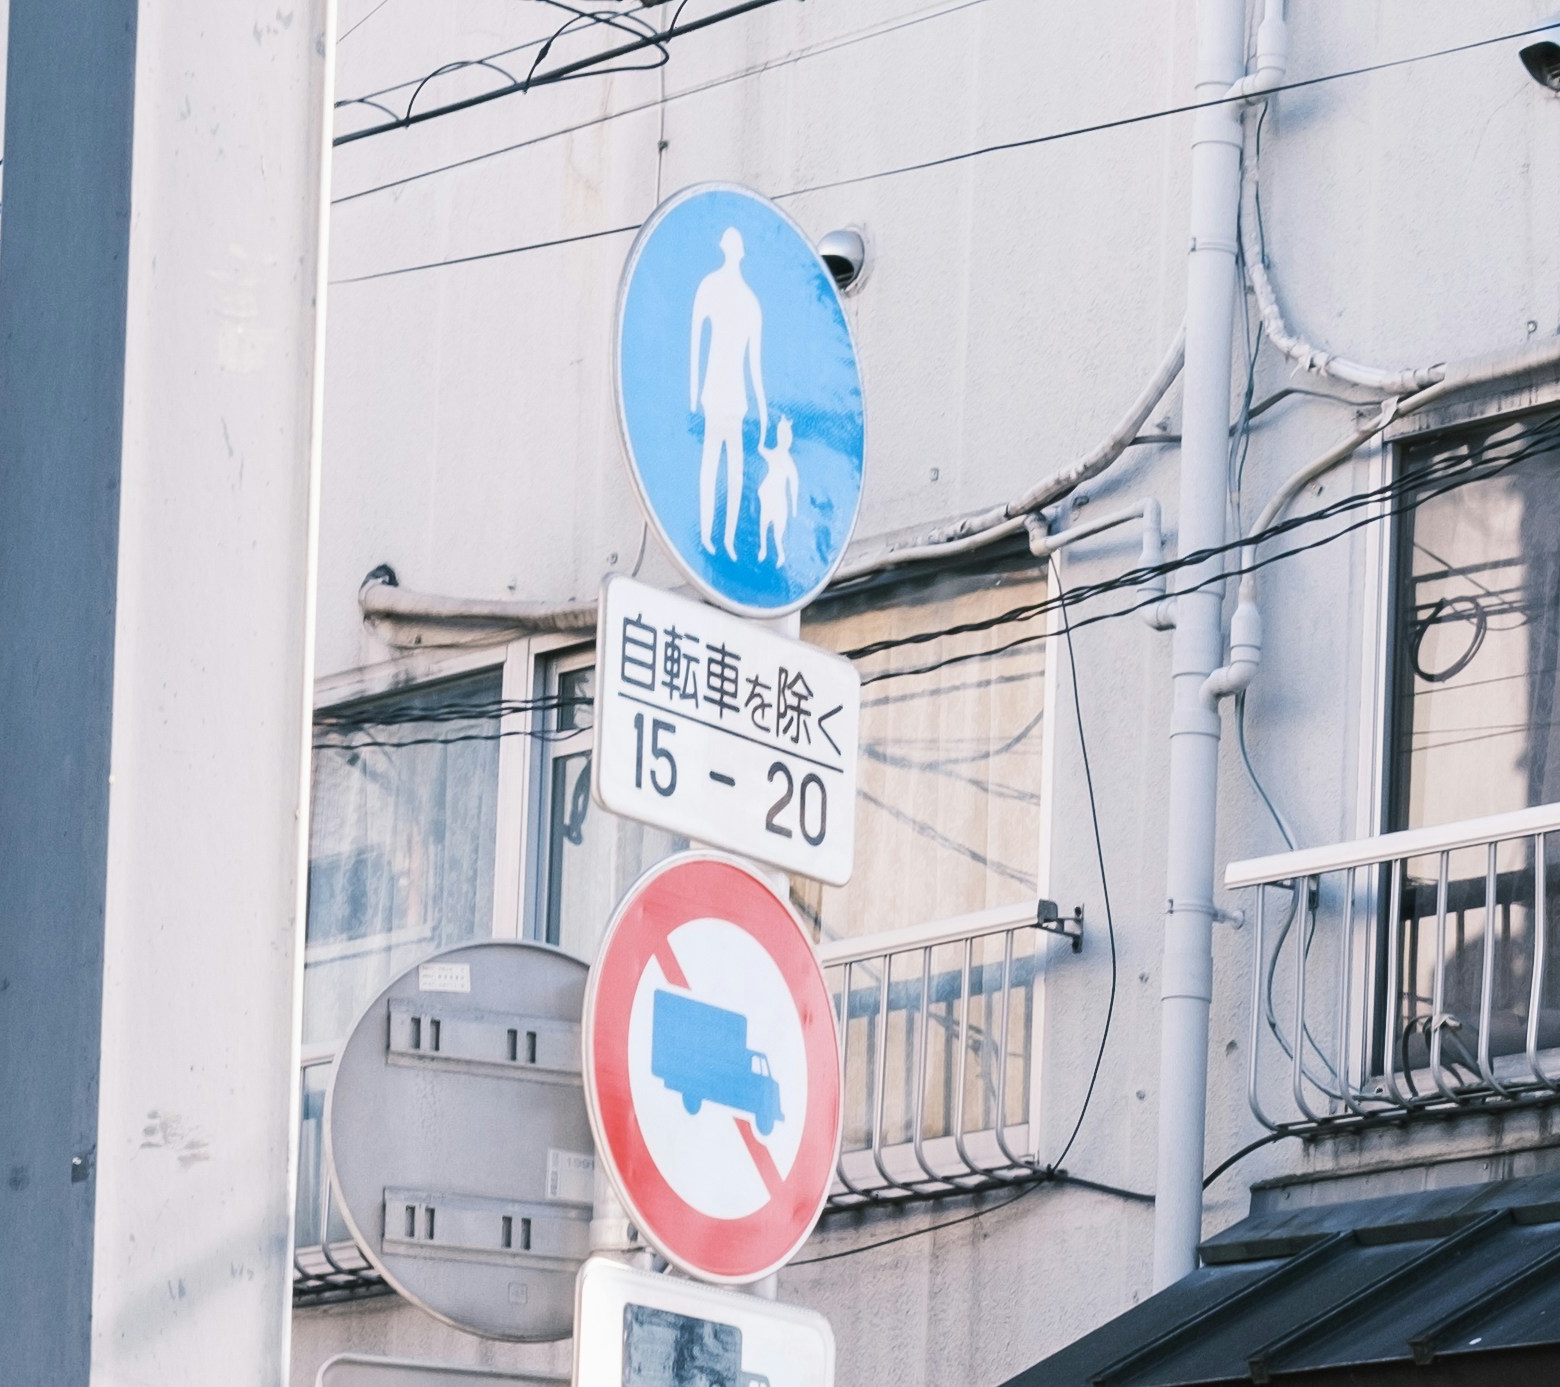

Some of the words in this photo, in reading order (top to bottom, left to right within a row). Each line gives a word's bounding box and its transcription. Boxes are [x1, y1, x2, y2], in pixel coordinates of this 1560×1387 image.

[621, 613, 844, 757] 自転車を除く
